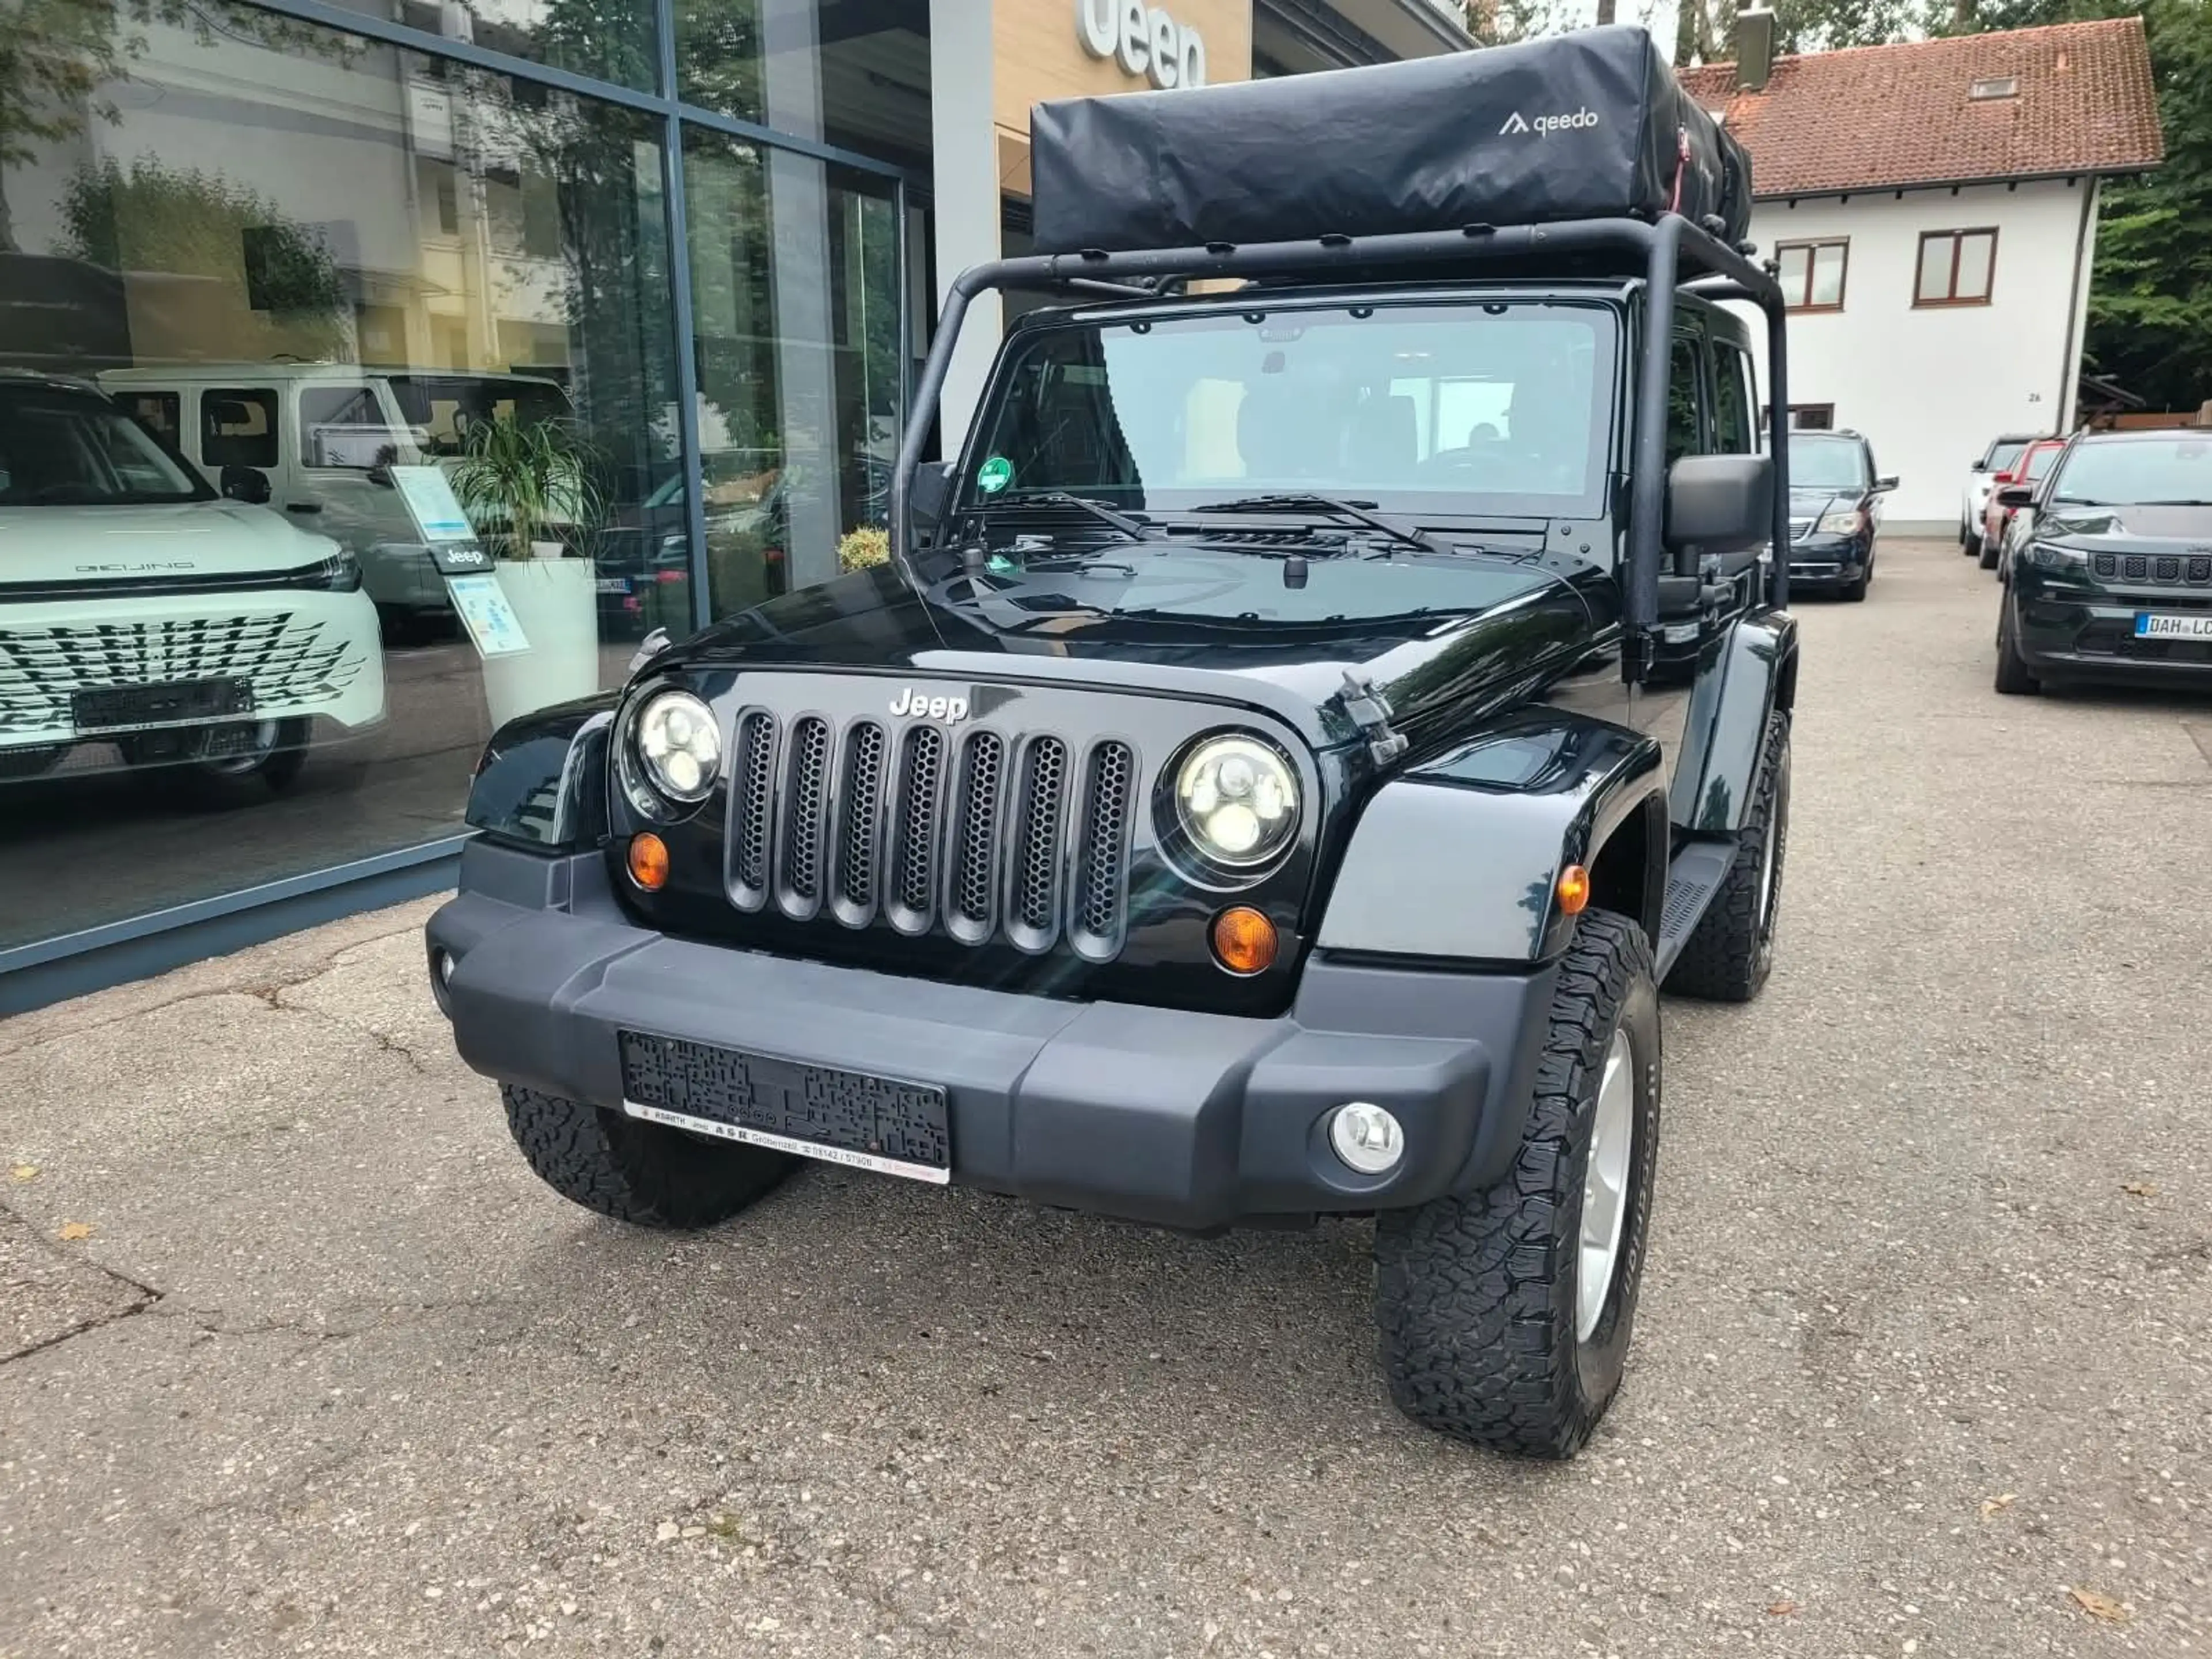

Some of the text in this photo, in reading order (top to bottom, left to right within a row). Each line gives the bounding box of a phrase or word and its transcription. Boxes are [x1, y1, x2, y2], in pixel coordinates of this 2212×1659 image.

[1533, 106, 1599, 139] qeedo
[448, 548, 483, 565] Jeep
[2150, 618, 2181, 633] DAH
[889, 687, 968, 725] Jeep
